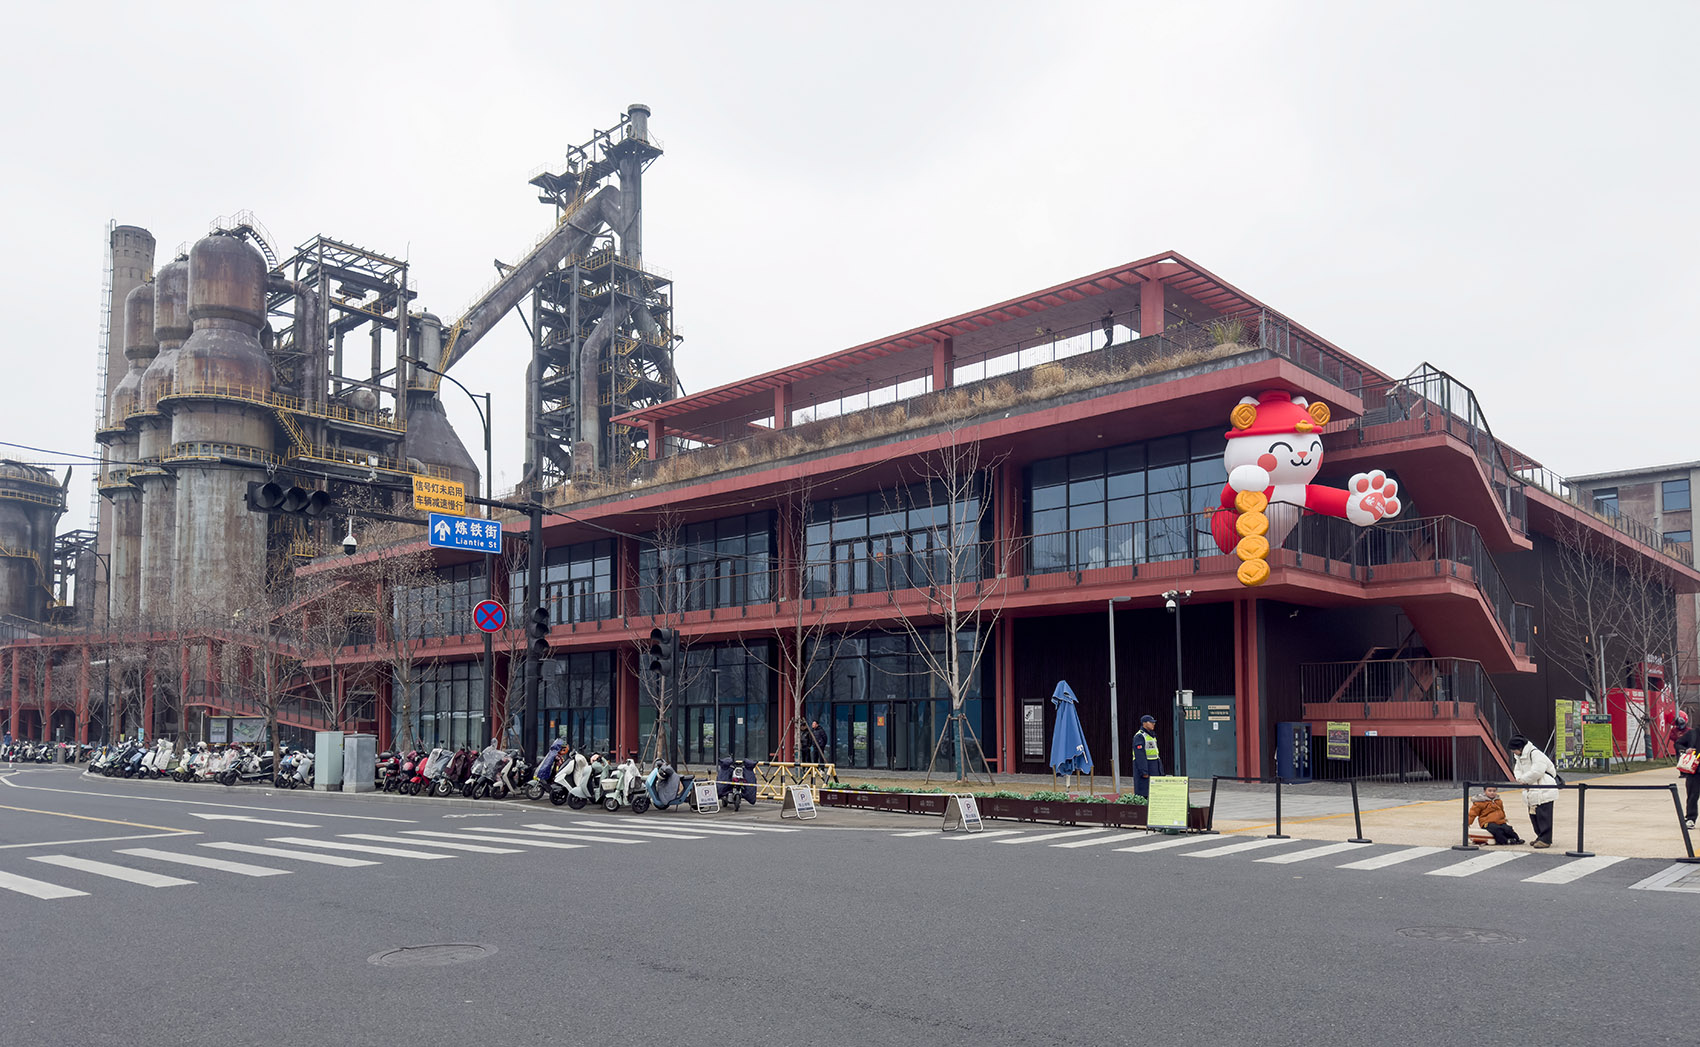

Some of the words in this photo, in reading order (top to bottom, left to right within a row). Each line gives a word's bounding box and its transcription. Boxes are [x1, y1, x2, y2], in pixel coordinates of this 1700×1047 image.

[416, 480, 462, 498] 信号灯未启用
[416, 494, 464, 512] 车辆减速慢行
[454, 520, 498, 540] 炼铁街
[456, 537, 484, 547] Liantie
